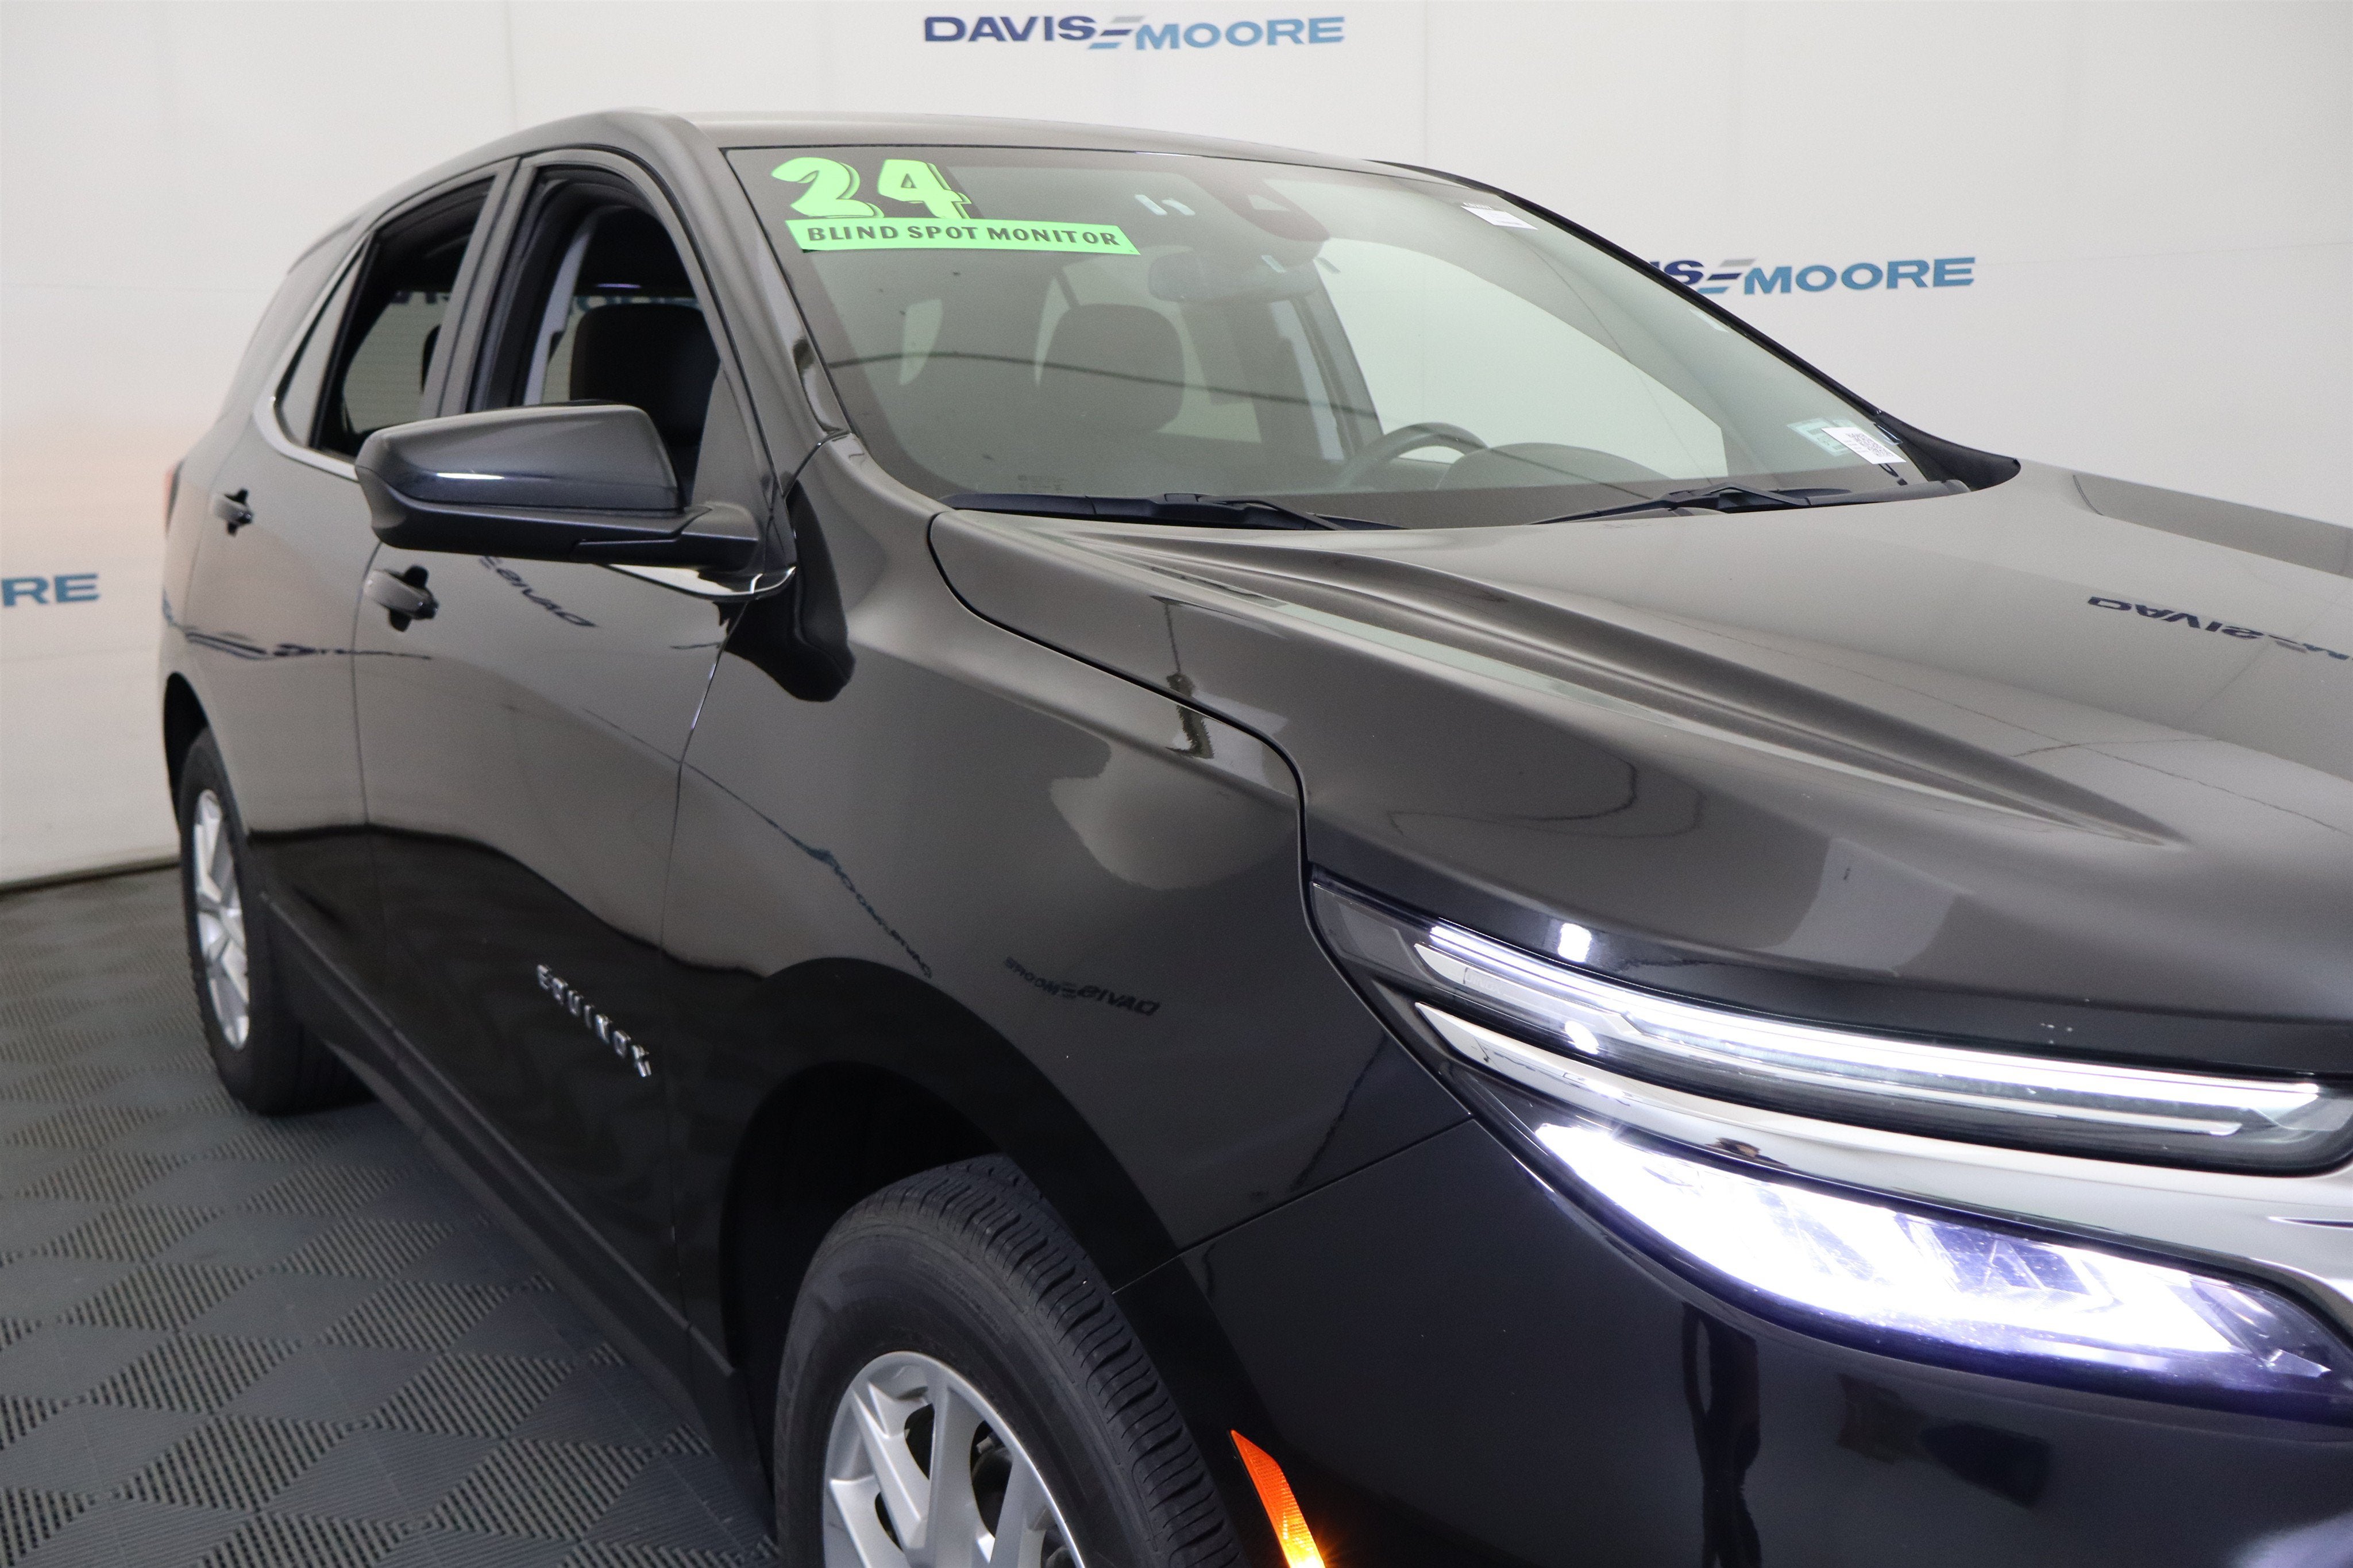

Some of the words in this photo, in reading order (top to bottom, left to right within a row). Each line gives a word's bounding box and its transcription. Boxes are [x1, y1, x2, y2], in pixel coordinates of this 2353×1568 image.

[924, 16, 1096, 43] DAVIS
[1134, 16, 1346, 51] MOORE
[772, 157, 971, 219] 24
[807, 226, 898, 242] BLIND
[908, 226, 979, 241] SPOT
[986, 227, 1121, 246] MONITOR
[1743, 257, 1976, 296] MOORE
